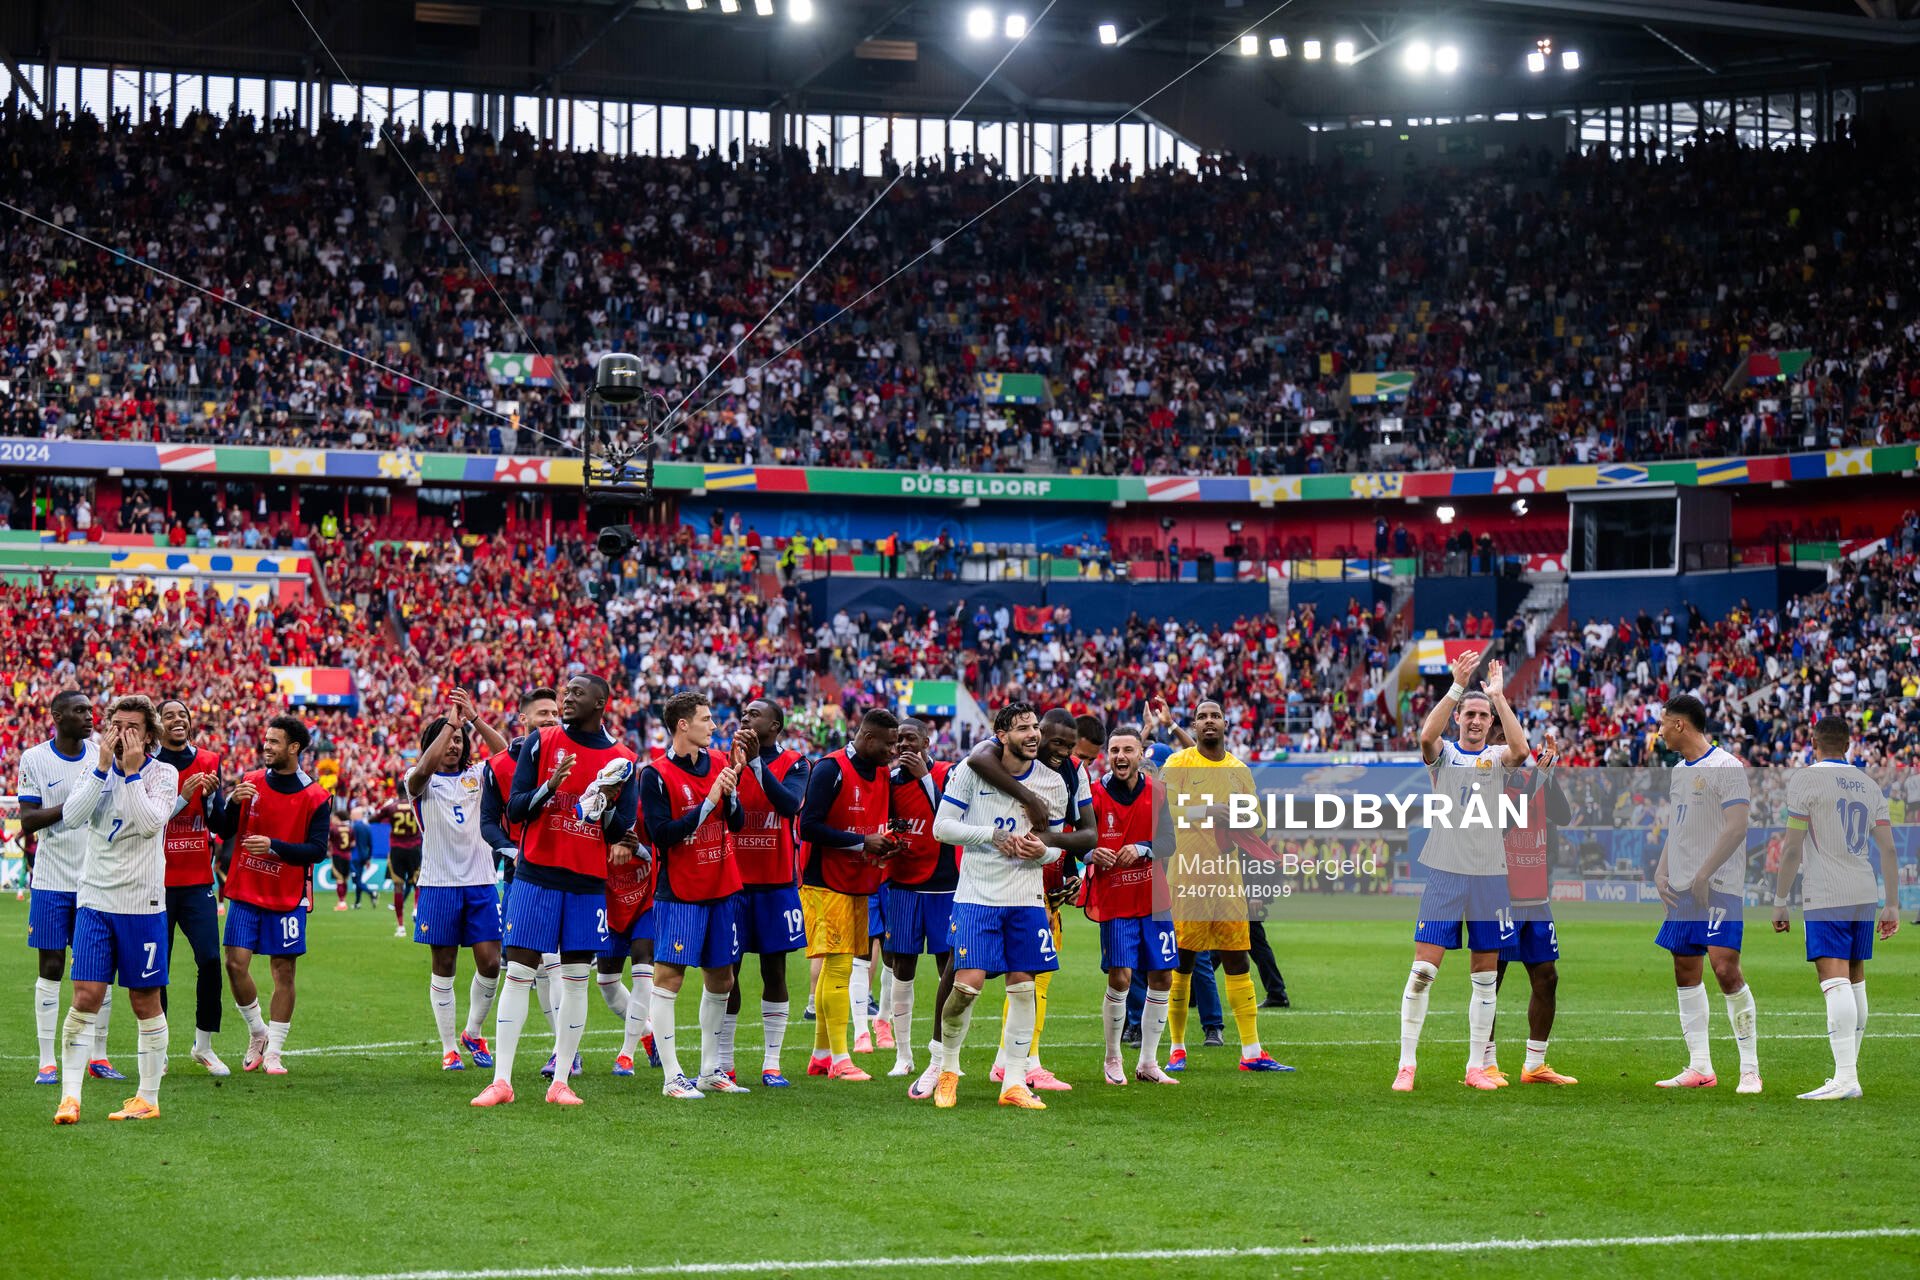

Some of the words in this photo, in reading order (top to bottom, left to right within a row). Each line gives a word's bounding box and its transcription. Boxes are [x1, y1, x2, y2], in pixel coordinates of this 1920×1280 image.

[1, 443, 50, 461] 2024
[901, 474, 1051, 496] DÜSSELDORF
[393, 811, 417, 835] 24
[453, 805, 465, 825] 5
[1836, 798, 1869, 855] 10
[107, 819, 123, 842] 7
[168, 840, 206, 850] RESPECT
[738, 838, 777, 847] RESPECT
[246, 858, 281, 874] RESPECT
[1122, 868, 1153, 882] RESPEC
[280, 916, 299, 939] 18
[784, 908, 803, 933] 19
[1496, 907, 1514, 932] 14
[1708, 906, 1727, 930] 17
[1159, 930, 1177, 954] 21
[143, 942, 157, 969] 7
